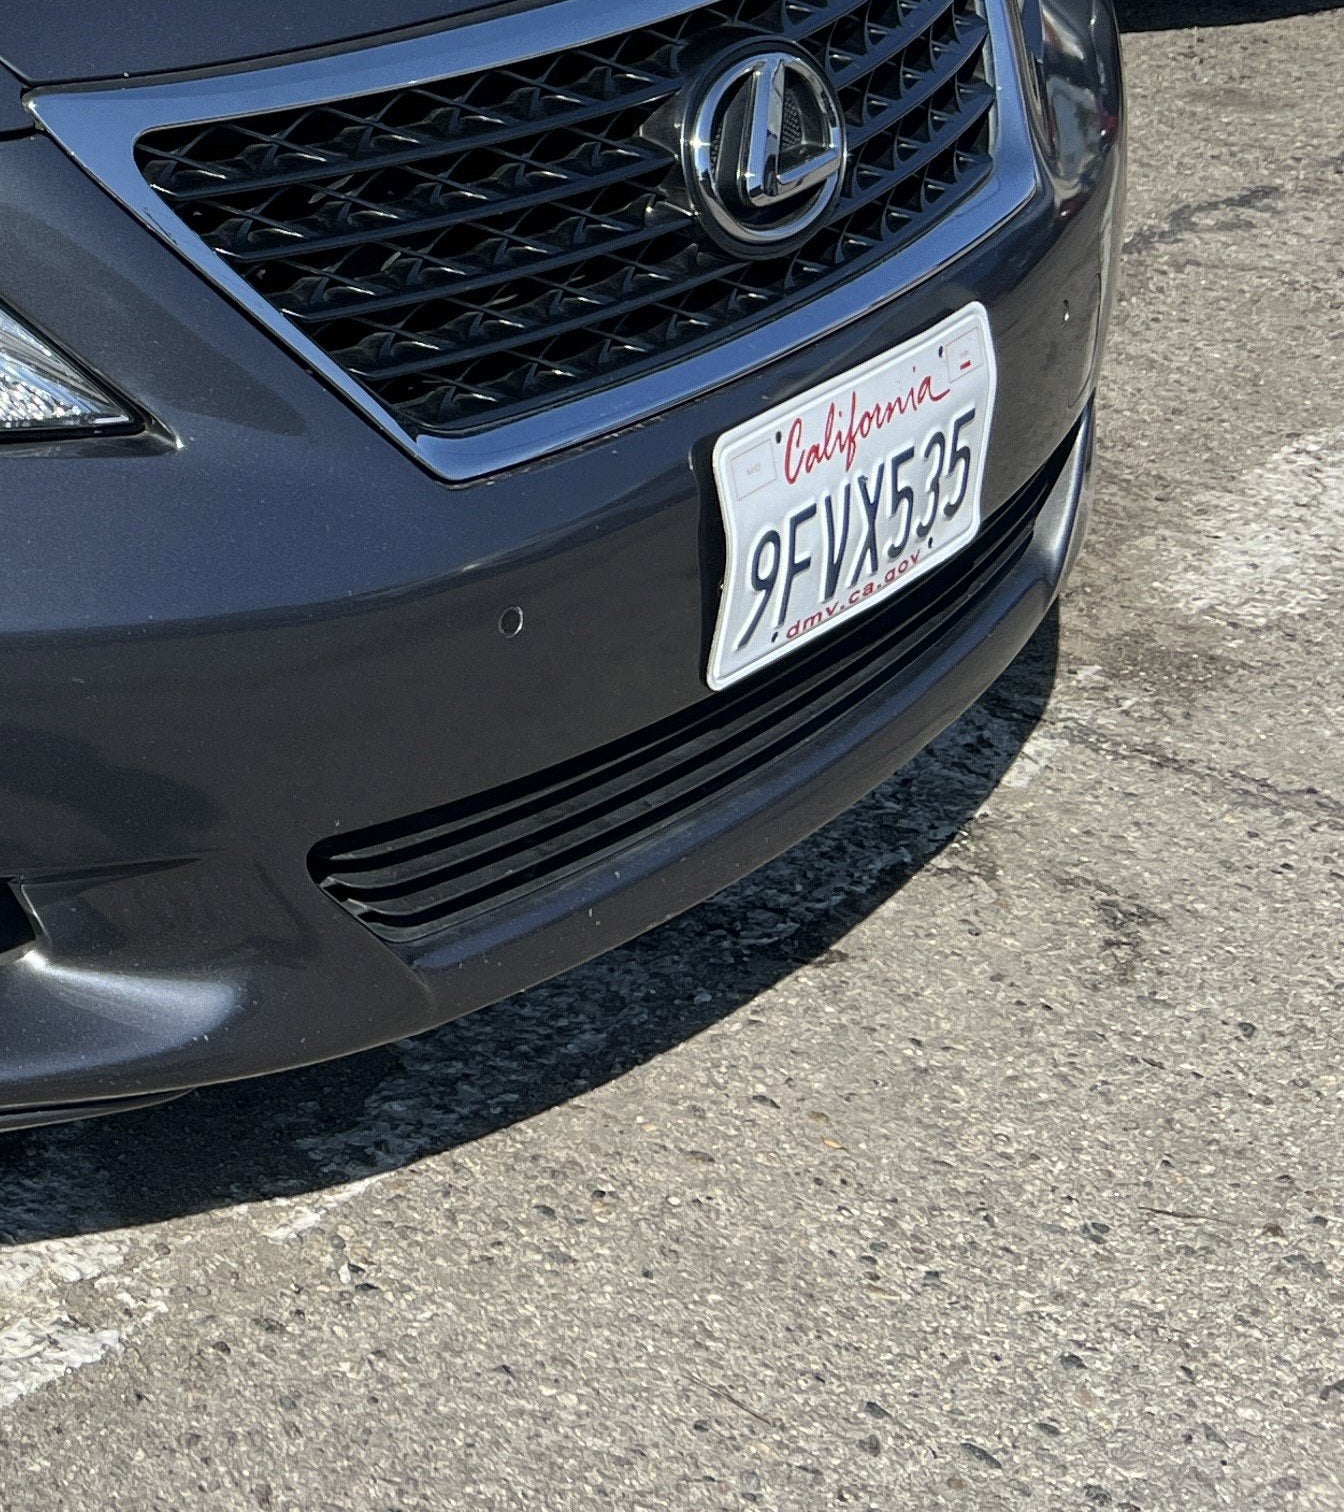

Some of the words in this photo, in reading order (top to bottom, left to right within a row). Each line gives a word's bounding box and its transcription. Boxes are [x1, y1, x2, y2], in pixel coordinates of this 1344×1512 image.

[784, 366, 950, 485] California
[735, 407, 976, 651] 9FVX535
[786, 549, 921, 642] dmv.ca.gov
